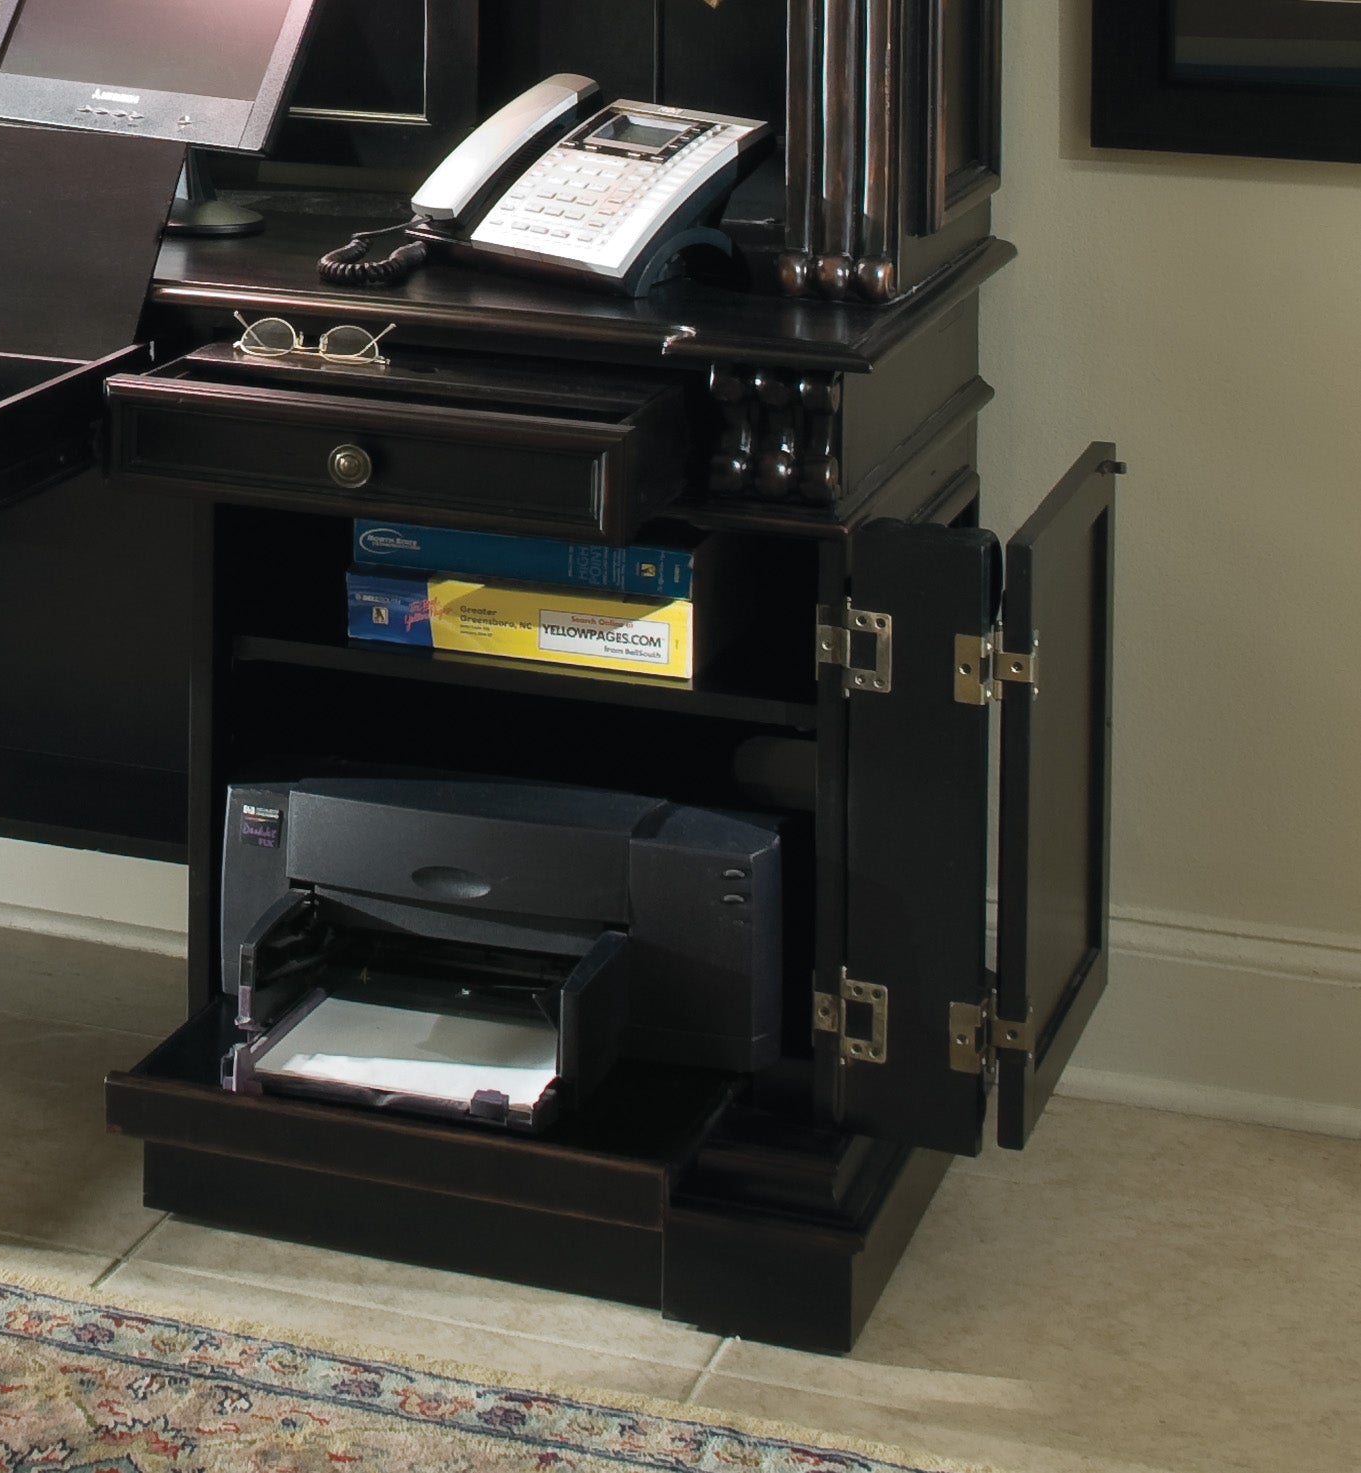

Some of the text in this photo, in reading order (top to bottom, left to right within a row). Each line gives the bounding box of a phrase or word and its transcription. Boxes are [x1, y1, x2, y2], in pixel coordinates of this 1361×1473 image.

[577, 546, 589, 580] HIGH
[589, 545, 602, 585] POINT
[460, 605, 498, 616] Greater
[460, 615, 517, 629] Greensboro,
[519, 621, 533, 630] NC
[571, 615, 596, 625] Search
[598, 619, 624, 628] Online
[542, 623, 662, 649] YELLOWPAGES.COM
[603, 645, 662, 659] from BellSouth
